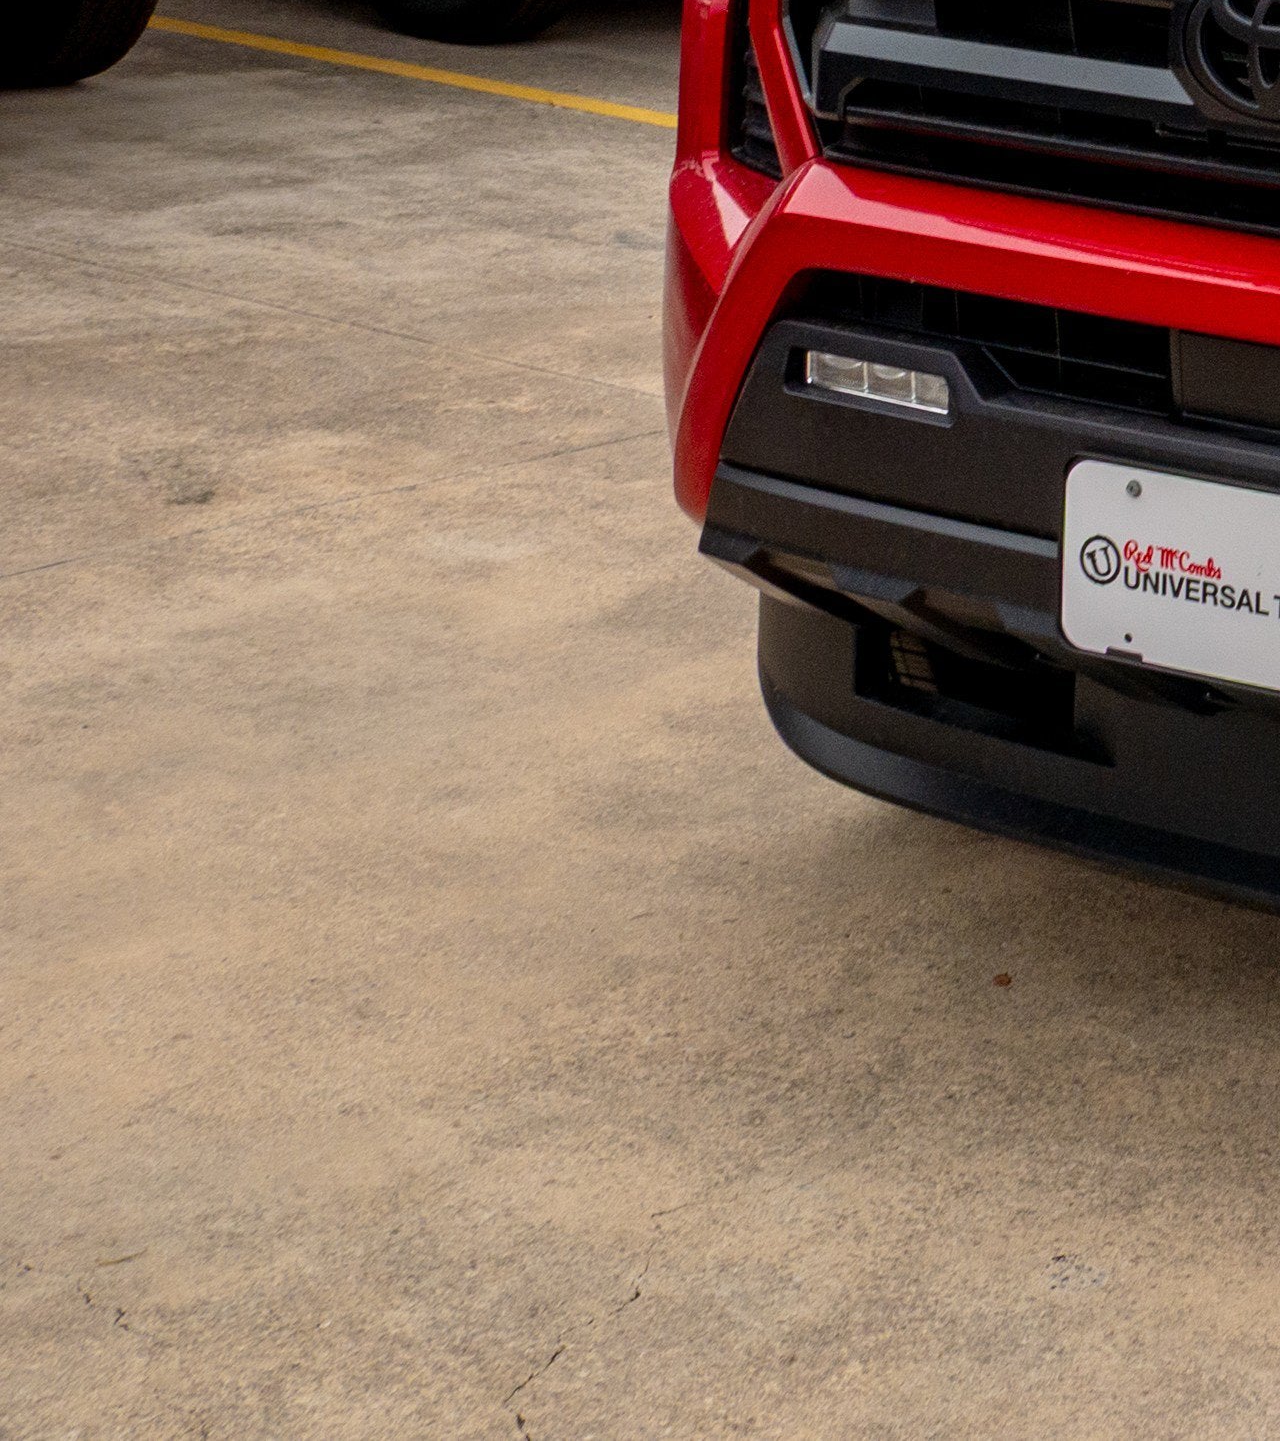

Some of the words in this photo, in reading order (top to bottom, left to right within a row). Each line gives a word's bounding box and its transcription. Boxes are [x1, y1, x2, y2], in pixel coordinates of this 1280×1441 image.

[1123, 539, 1154, 573] Red
[1156, 545, 1222, 580] McCombs
[1124, 566, 1270, 617] UNIVERSAL
